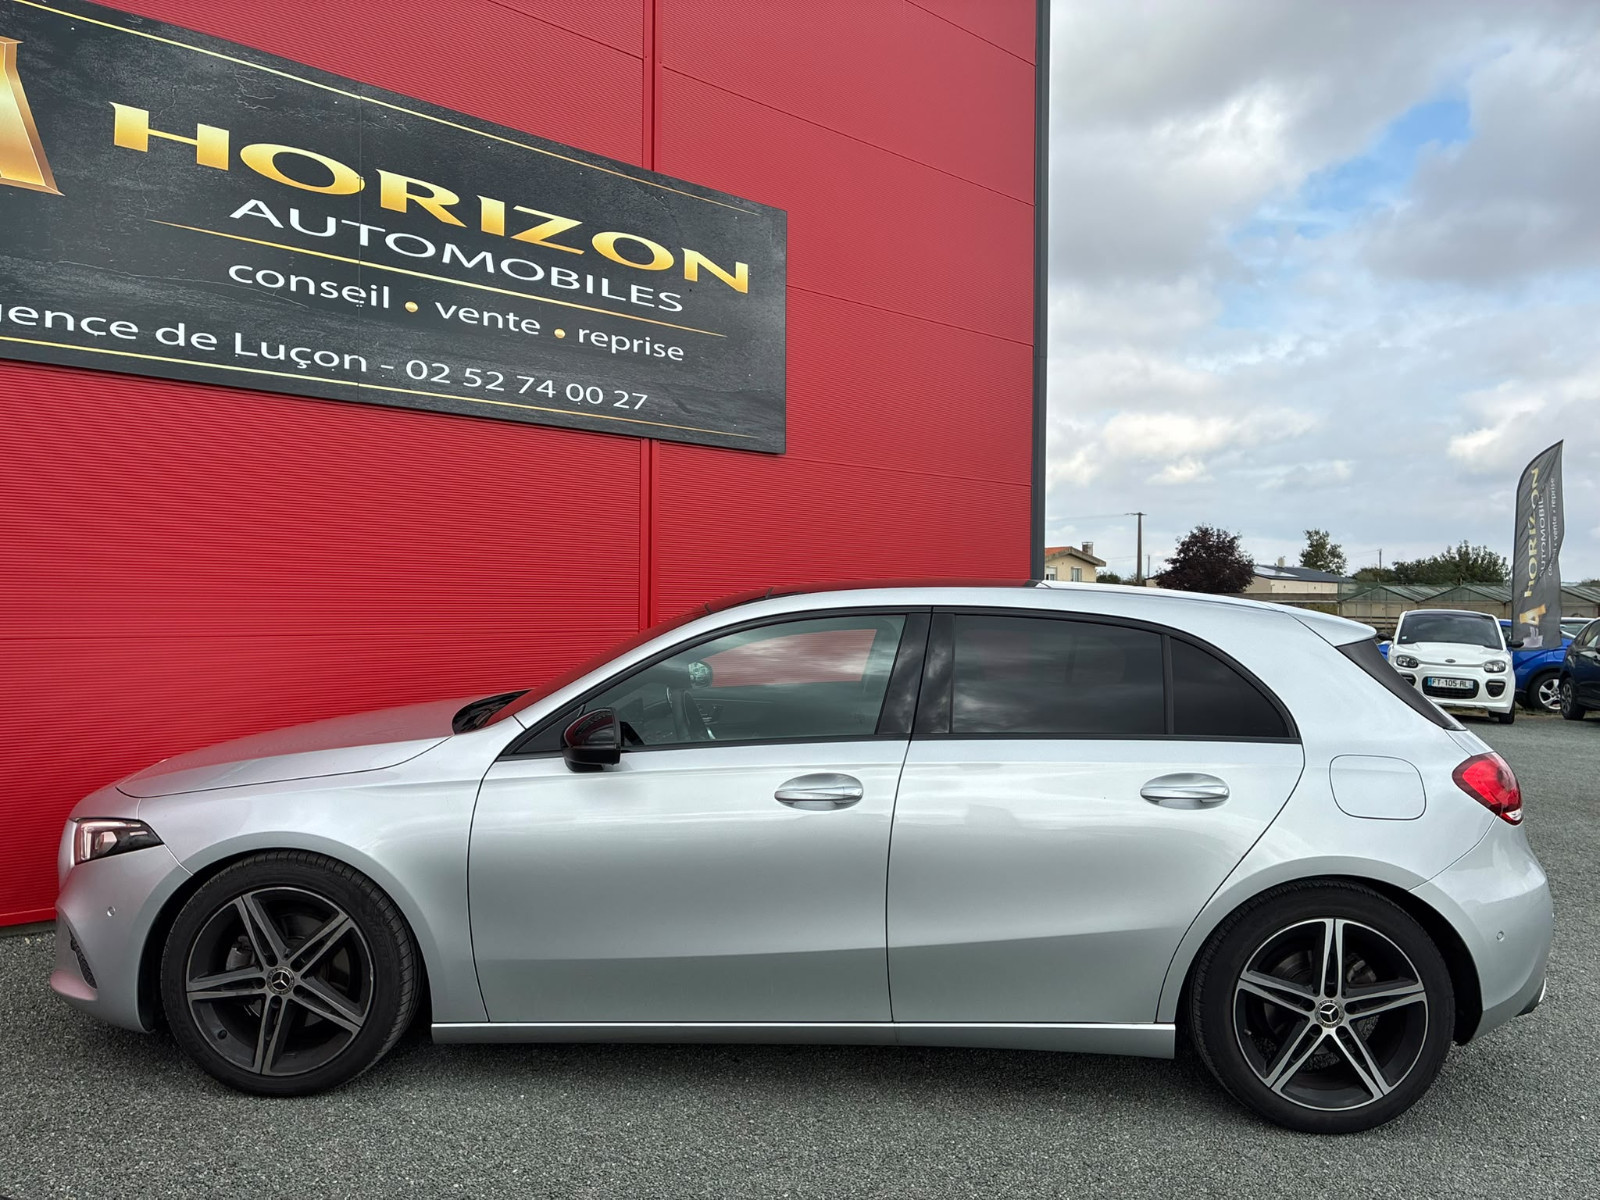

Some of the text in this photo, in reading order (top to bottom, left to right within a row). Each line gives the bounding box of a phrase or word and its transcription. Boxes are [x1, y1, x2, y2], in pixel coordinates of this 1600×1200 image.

[109, 101, 749, 294] HORIZON
[229, 199, 683, 313] AUTOMOBILES
[0, 303, 139, 340] ence
[155, 322, 218, 351] de
[234, 331, 367, 372] Luçon
[405, 359, 451, 384] 02
[462, 367, 505, 391] 52
[516, 375, 557, 398] 74
[565, 382, 604, 404] 00
[613, 389, 648, 411] 27
[228, 264, 685, 361] conseil vente reprise
